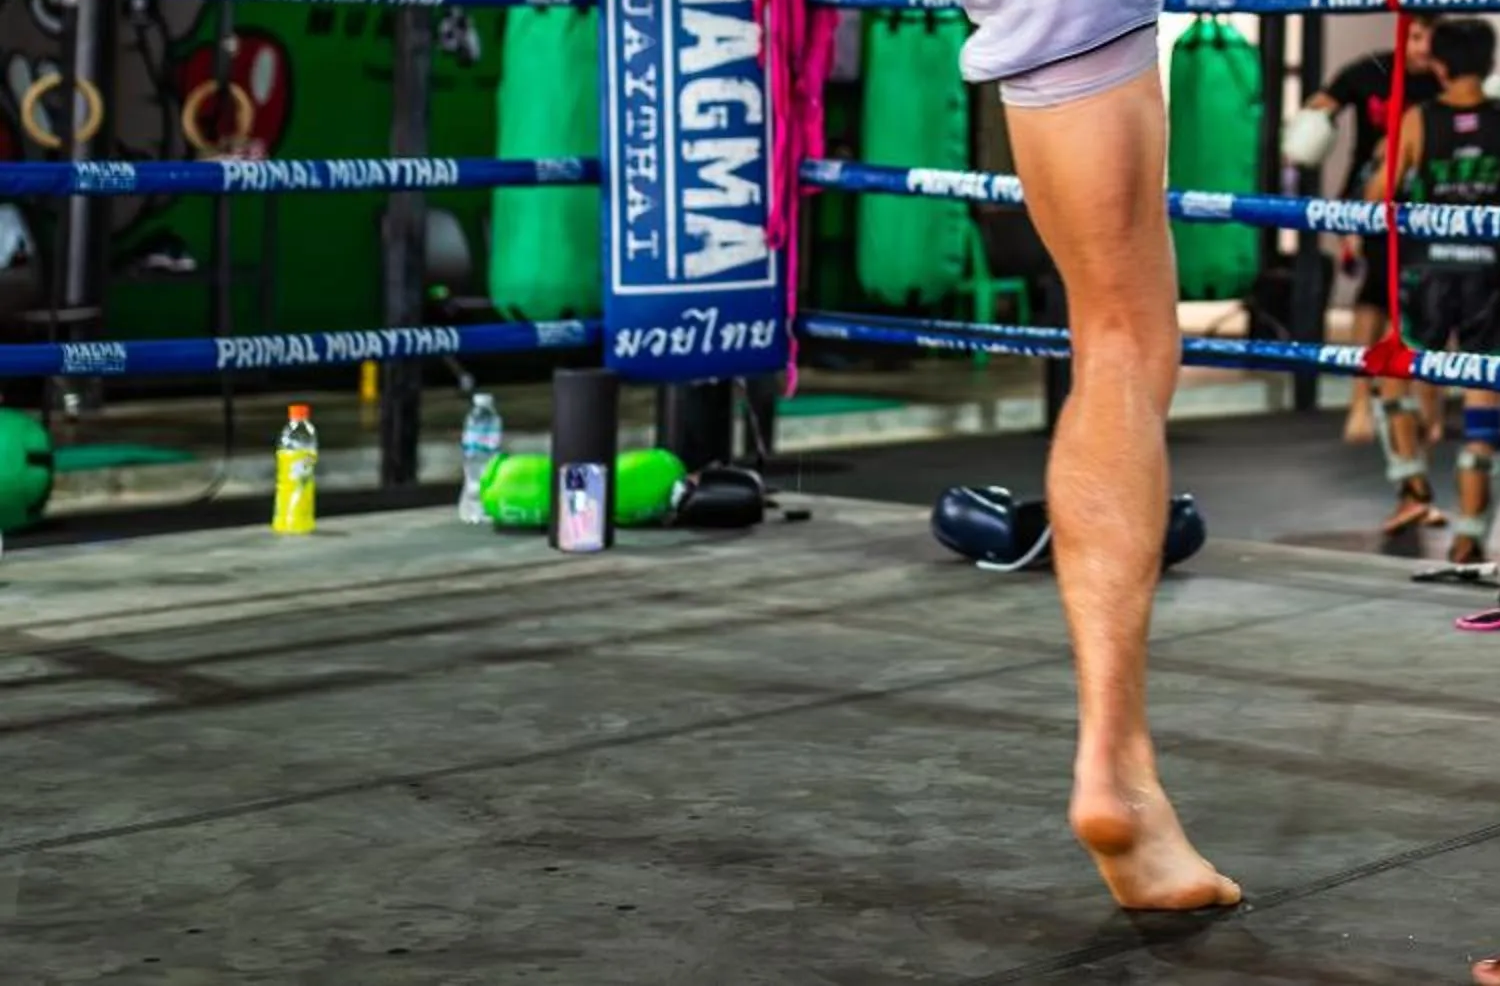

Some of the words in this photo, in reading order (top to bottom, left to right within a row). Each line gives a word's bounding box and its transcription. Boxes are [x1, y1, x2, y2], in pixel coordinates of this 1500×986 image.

[221, 160, 322, 191] PRIMAL
[329, 158, 459, 188] MUAYTHAI
[215, 333, 319, 369] PRIMAL
[323, 326, 459, 362] MUAYTHAI
